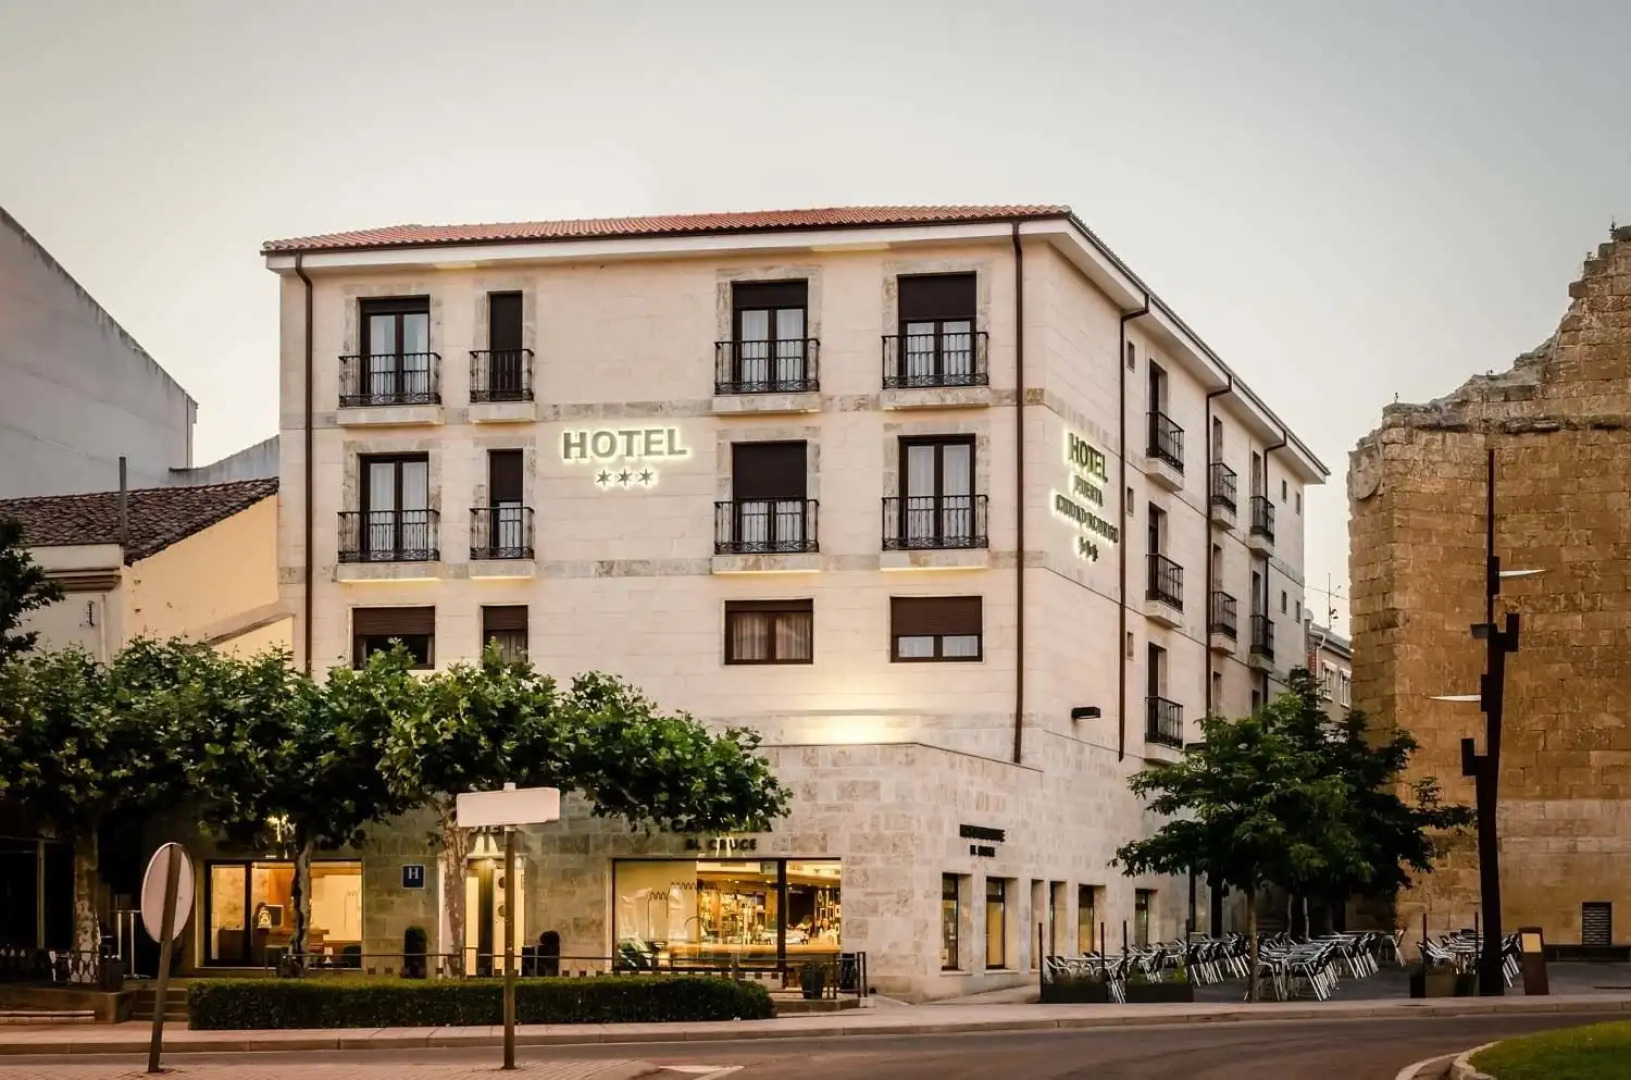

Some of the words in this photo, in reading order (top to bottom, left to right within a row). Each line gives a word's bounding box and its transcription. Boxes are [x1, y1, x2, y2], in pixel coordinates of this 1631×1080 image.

[563, 428, 688, 460] HOTEL
[1067, 431, 1109, 484] HOTEL
[407, 866, 420, 880] H
